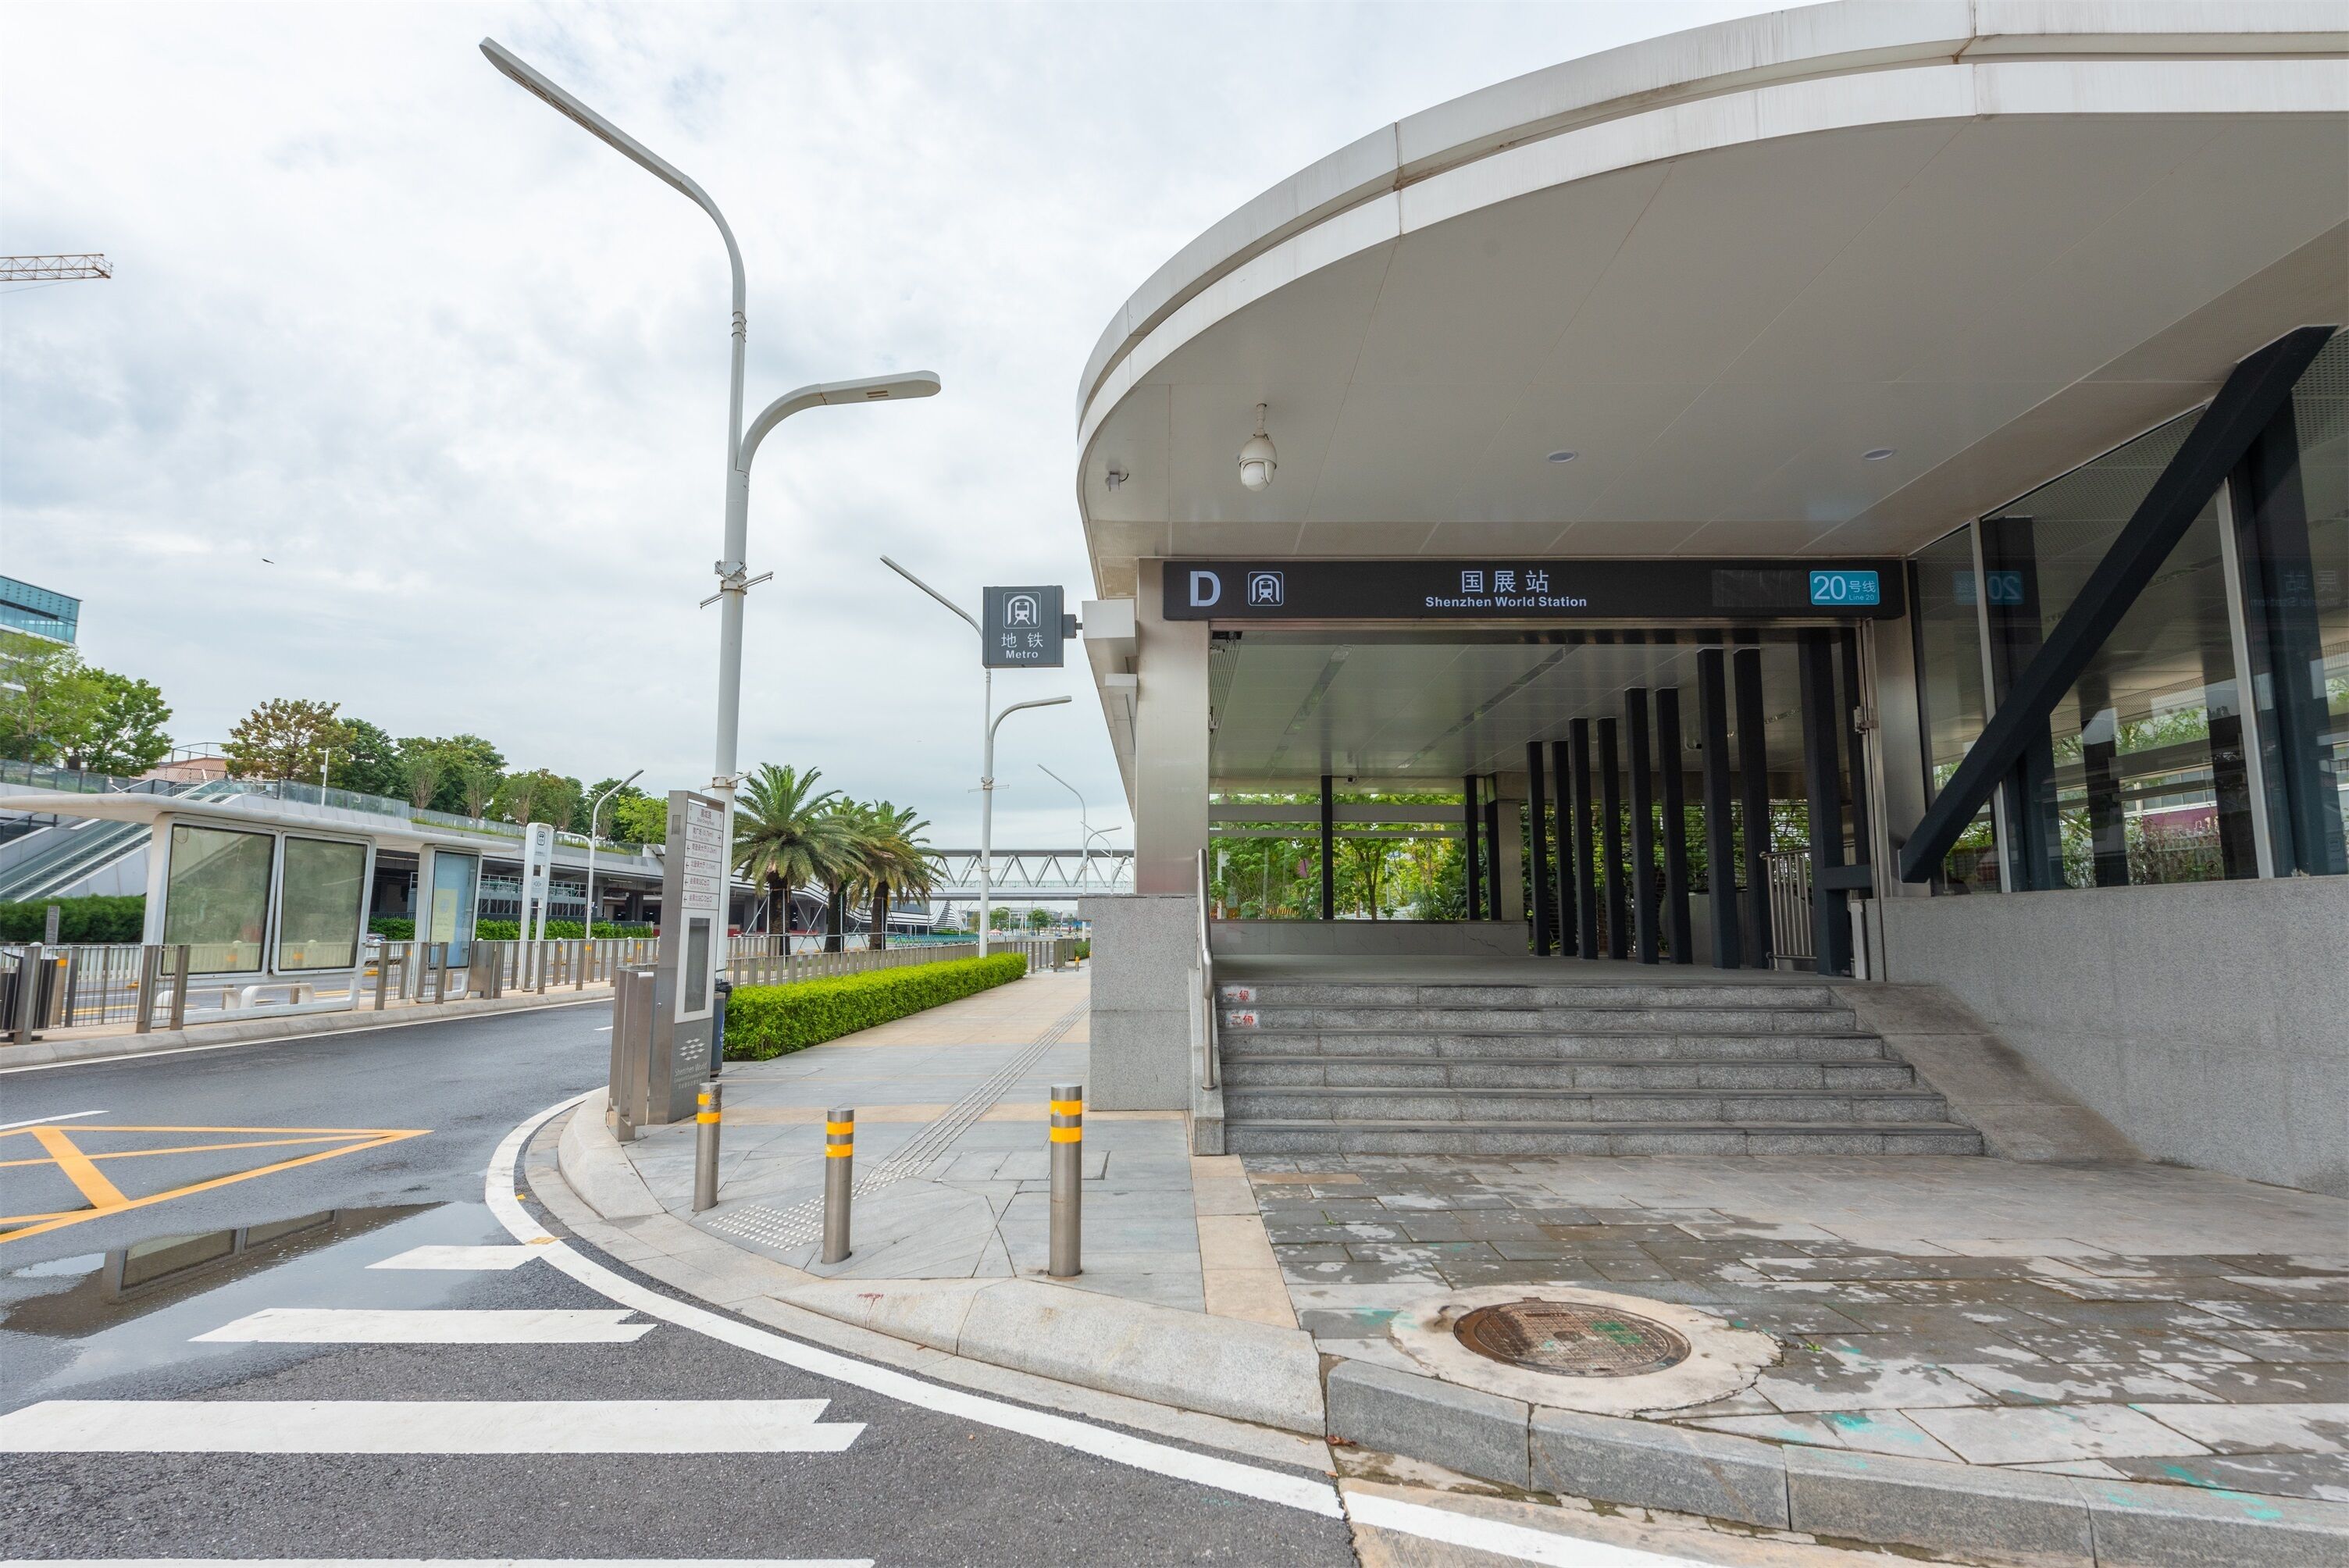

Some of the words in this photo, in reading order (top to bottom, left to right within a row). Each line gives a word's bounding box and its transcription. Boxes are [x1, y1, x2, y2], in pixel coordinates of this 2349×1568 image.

[1189, 571, 1221, 607] D
[1461, 569, 1549, 593] 国展站
[1425, 596, 1492, 607] Shenzhen
[1495, 596, 1535, 607] World
[1538, 596, 1588, 607] Station
[1000, 632, 1043, 648] 地铁
[1006, 650, 1039, 658] Metro
